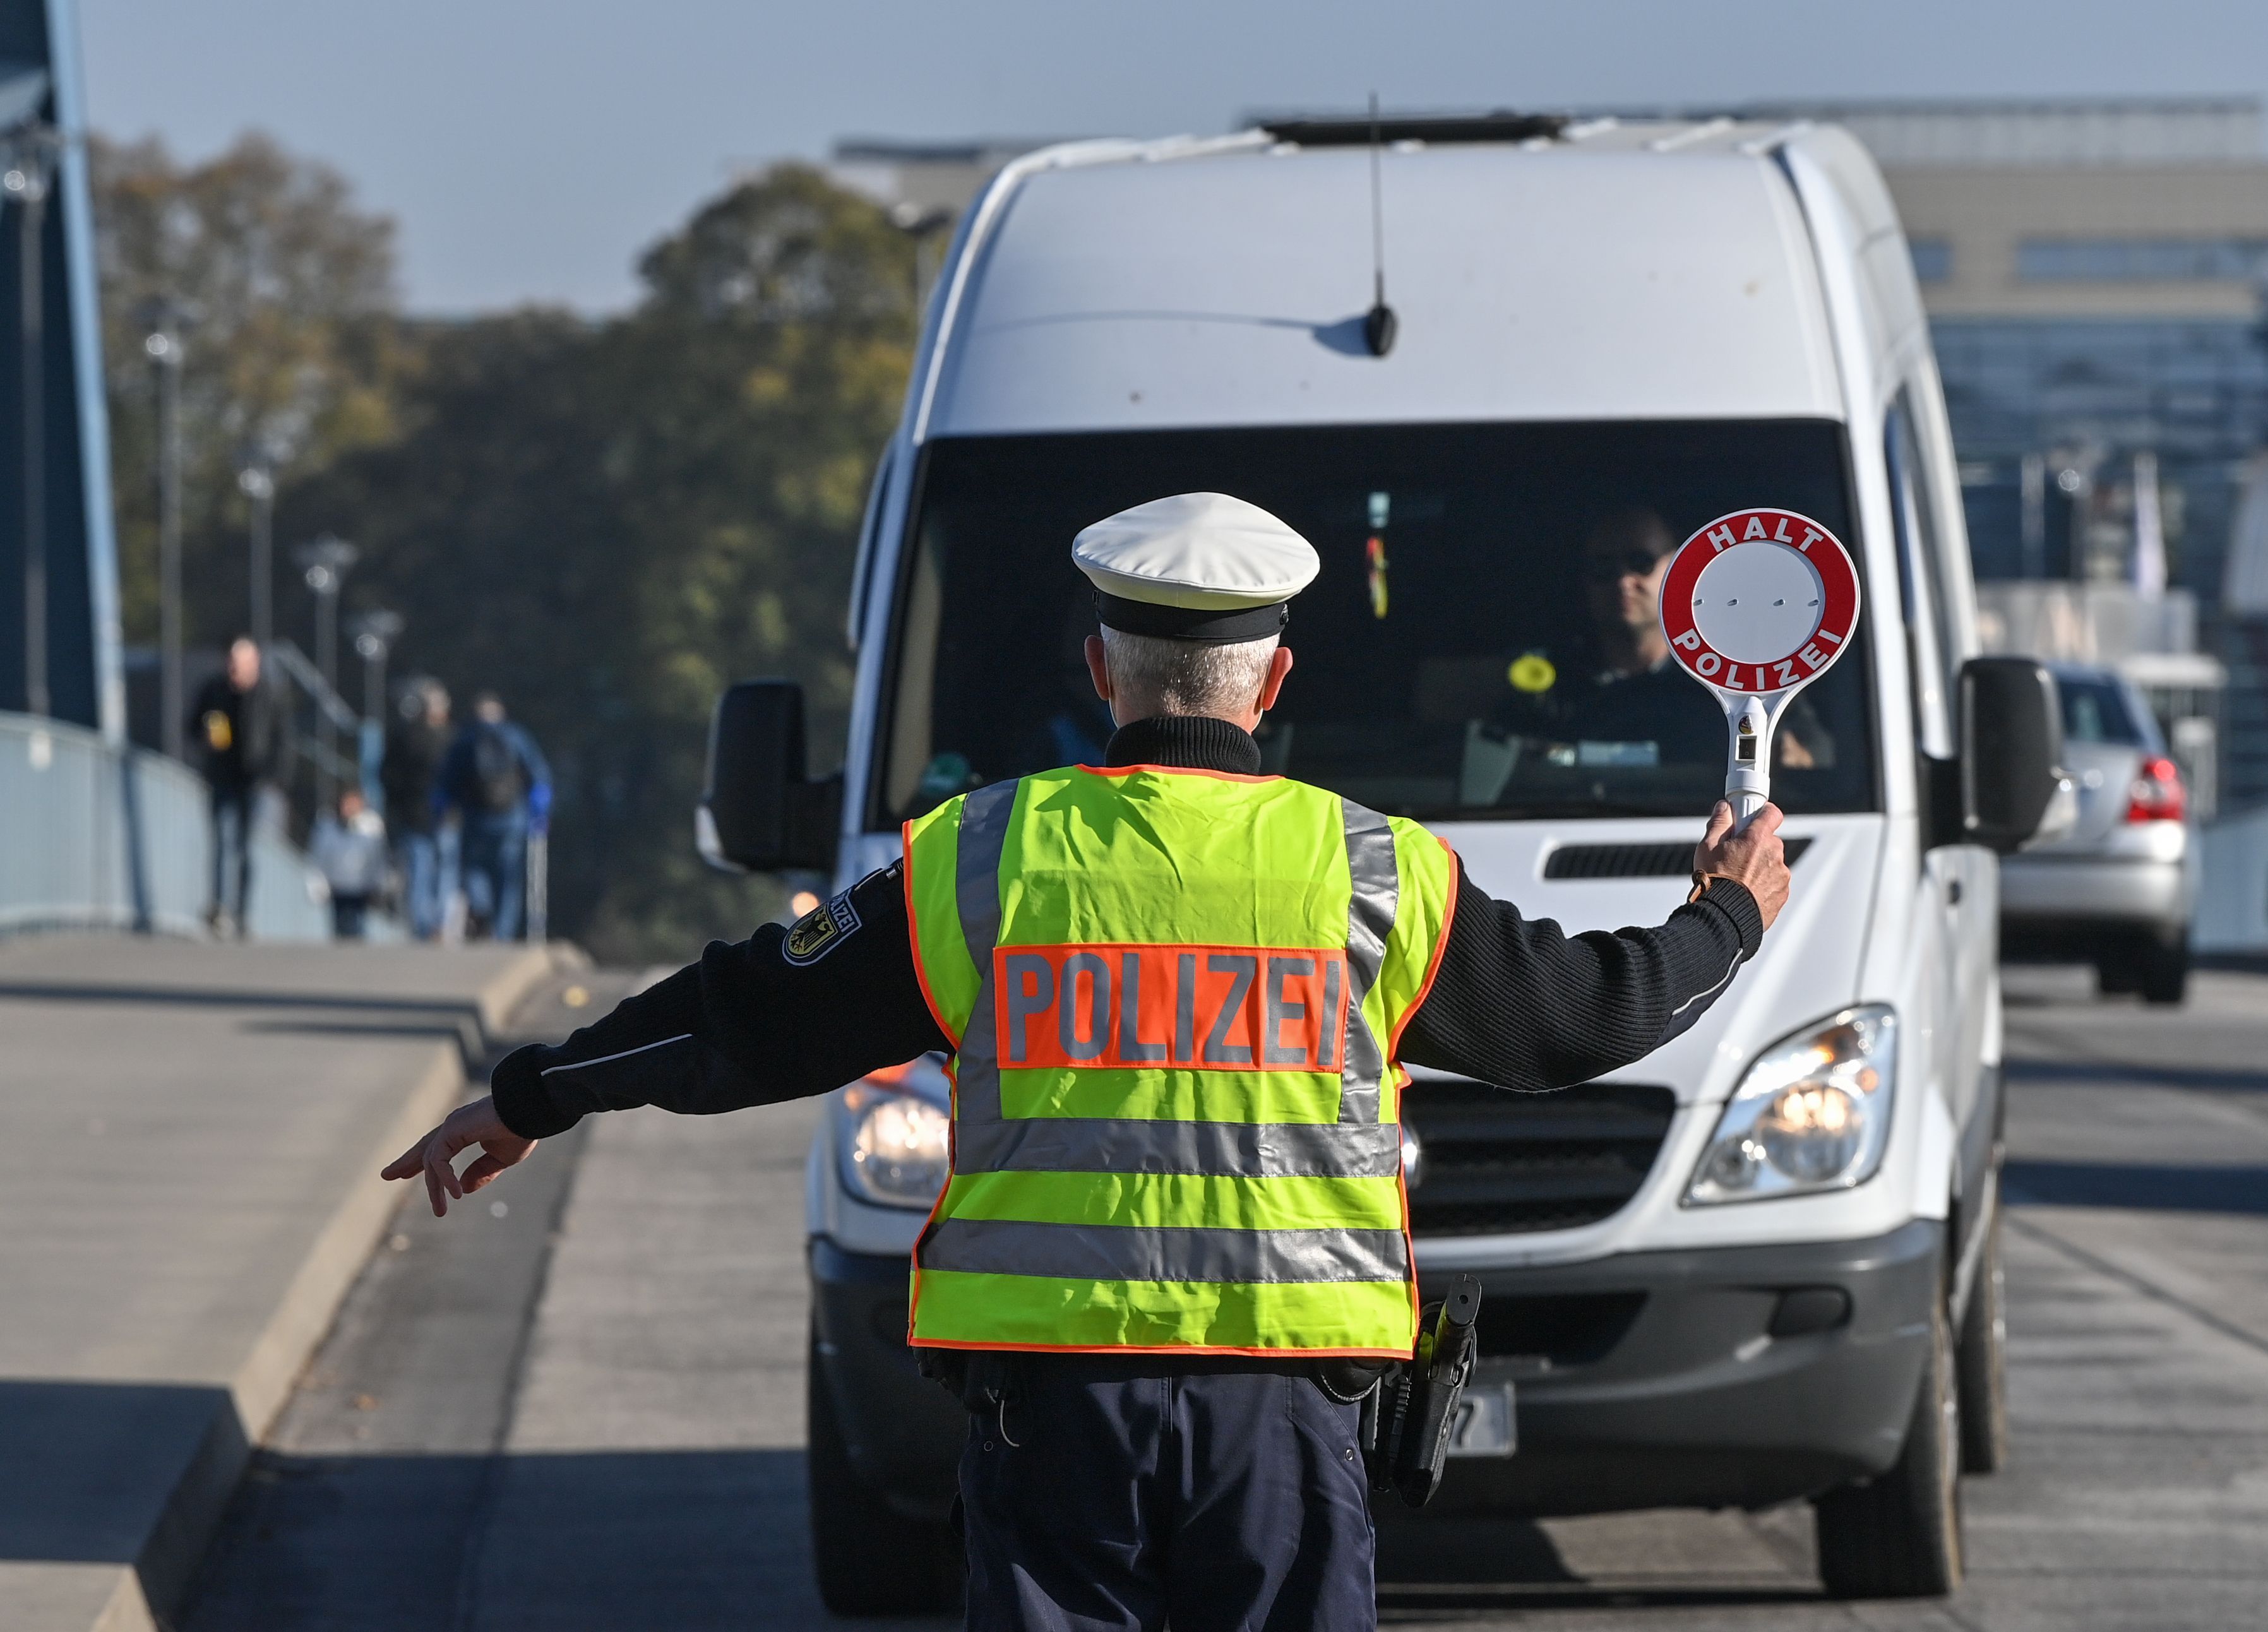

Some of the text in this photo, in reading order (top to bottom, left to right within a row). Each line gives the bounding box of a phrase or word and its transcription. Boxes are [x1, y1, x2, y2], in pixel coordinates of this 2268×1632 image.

[1707, 516, 1824, 552] HALT
[1672, 628, 1842, 690] POLIZEI
[1005, 953, 1342, 1066] POLIZEI
